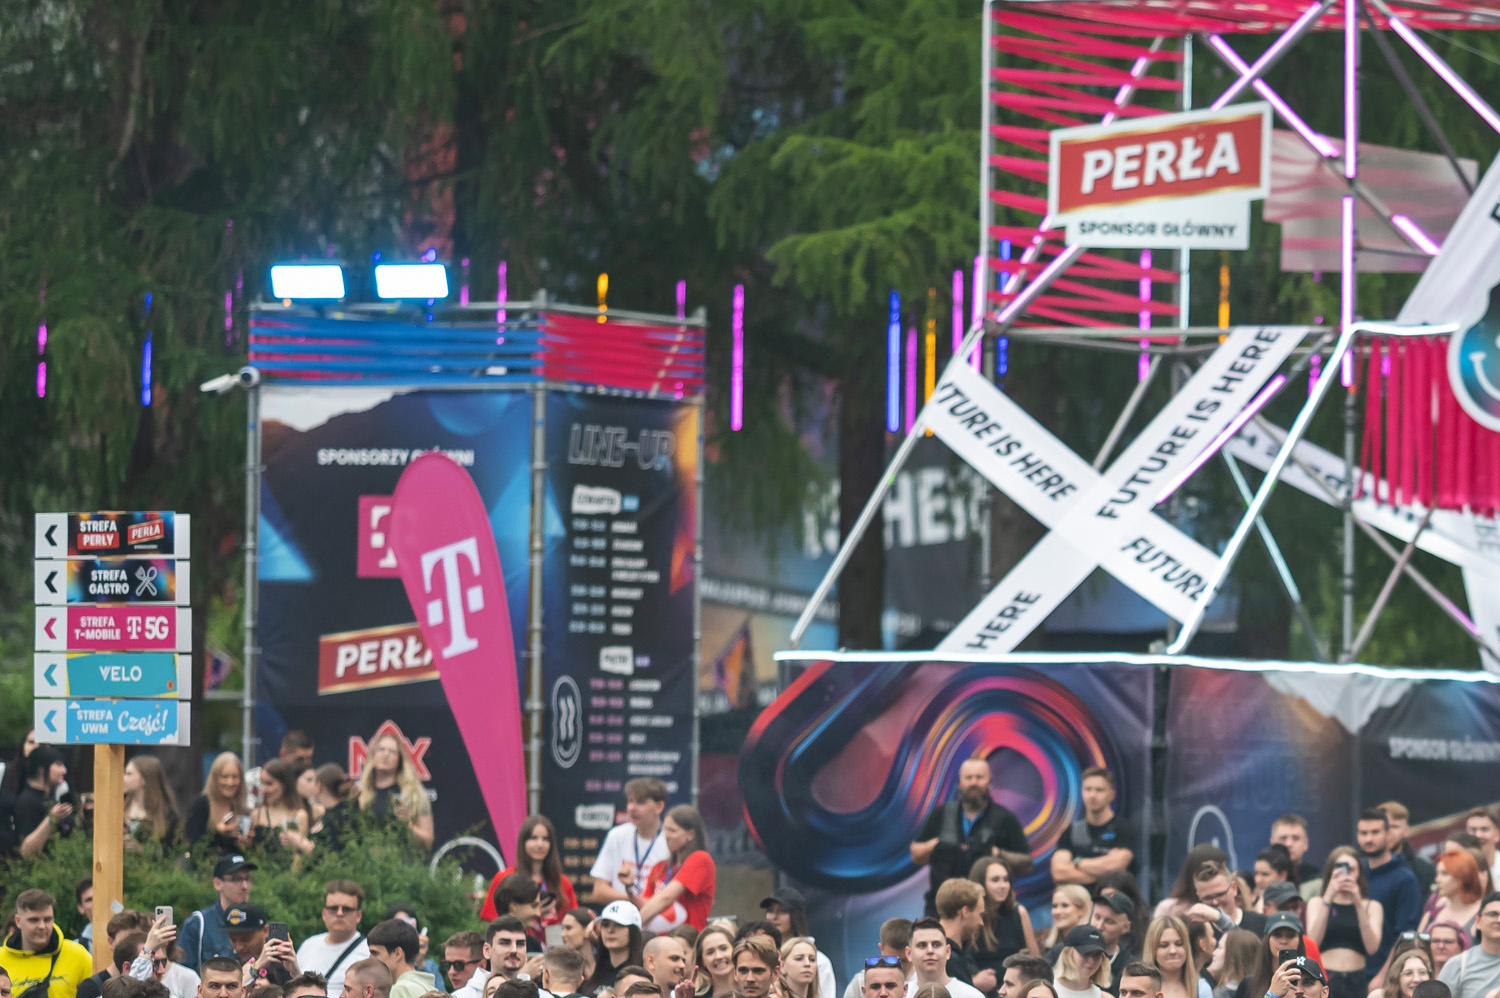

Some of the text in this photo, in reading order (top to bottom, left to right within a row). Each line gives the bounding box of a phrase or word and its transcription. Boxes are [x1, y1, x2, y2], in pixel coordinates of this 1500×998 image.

[1081, 131, 1240, 194] PERŁA
[1078, 218, 1237, 237] SPONSOR GŁÓWNY
[1097, 327, 1283, 520] FUTURE IS HERE
[317, 447, 408, 466] SPONSORZY
[990, 430, 1021, 457] IS
[1016, 453, 1078, 501] HERE
[80, 520, 117, 532] STREFA
[132, 524, 160, 539] PERŁA
[91, 570, 127, 581] STREFA
[89, 583, 129, 595] GASTRO
[420, 536, 485, 659] T
[80, 616, 115, 627] STREFA
[145, 616, 169, 640] 5G
[966, 590, 1042, 650] HERE
[75, 629, 121, 640] T-MOBILE
[335, 635, 433, 678] PERŁ
[99, 665, 142, 681] VELO
[77, 710, 113, 720] STREFA
[82, 723, 108, 733] UWM
